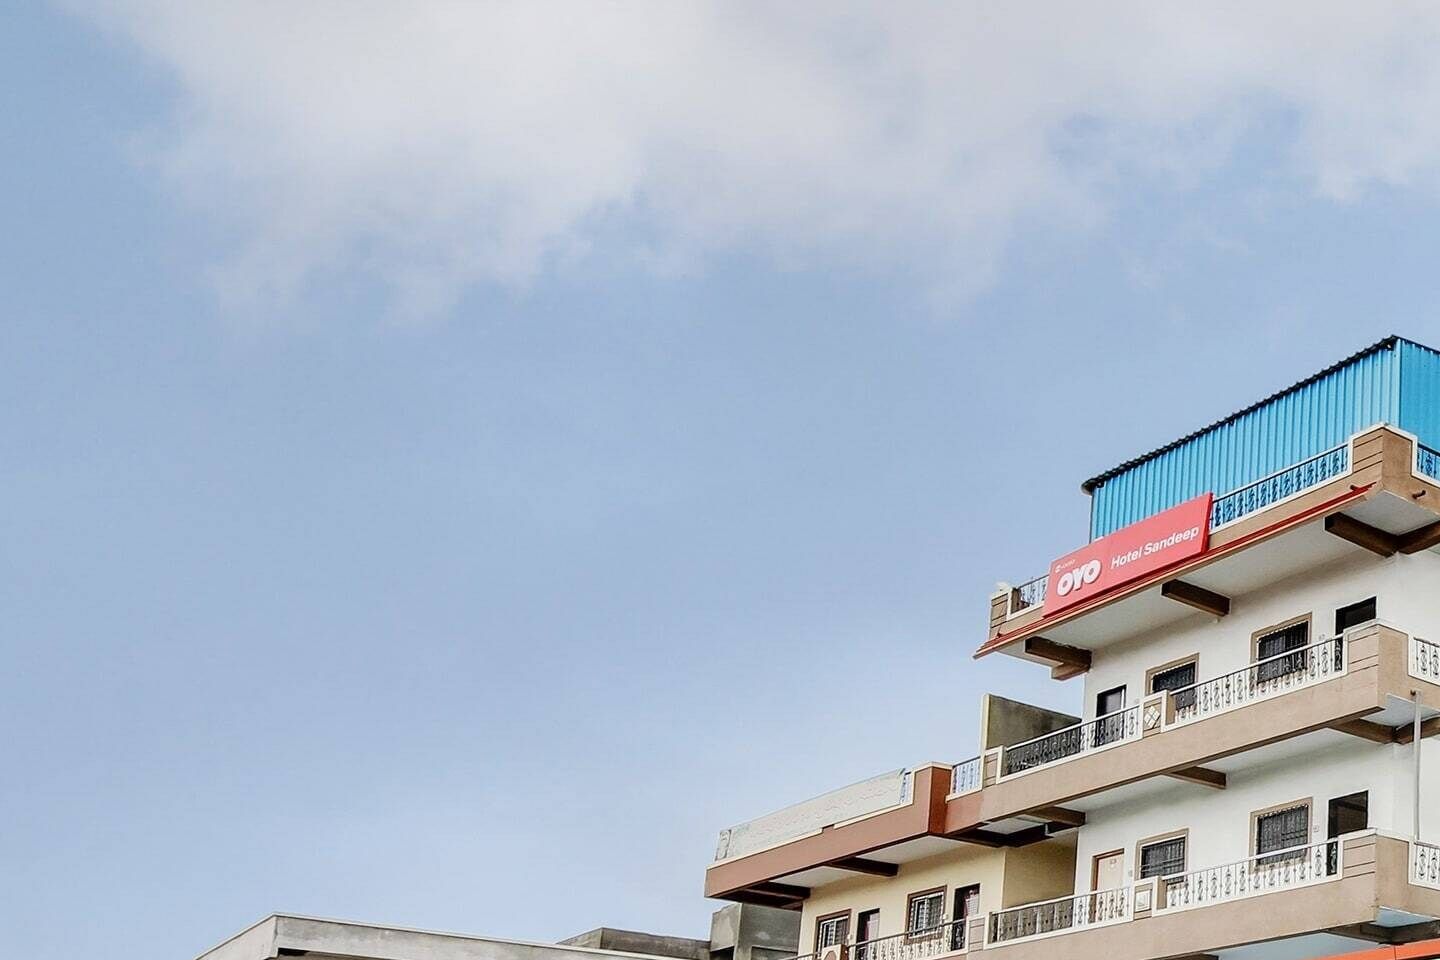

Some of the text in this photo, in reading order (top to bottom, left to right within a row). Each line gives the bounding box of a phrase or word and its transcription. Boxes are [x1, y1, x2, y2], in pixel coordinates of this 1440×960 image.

[1111, 526, 1200, 569] Hotel Sandeep
[1057, 560, 1102, 596] OYO
